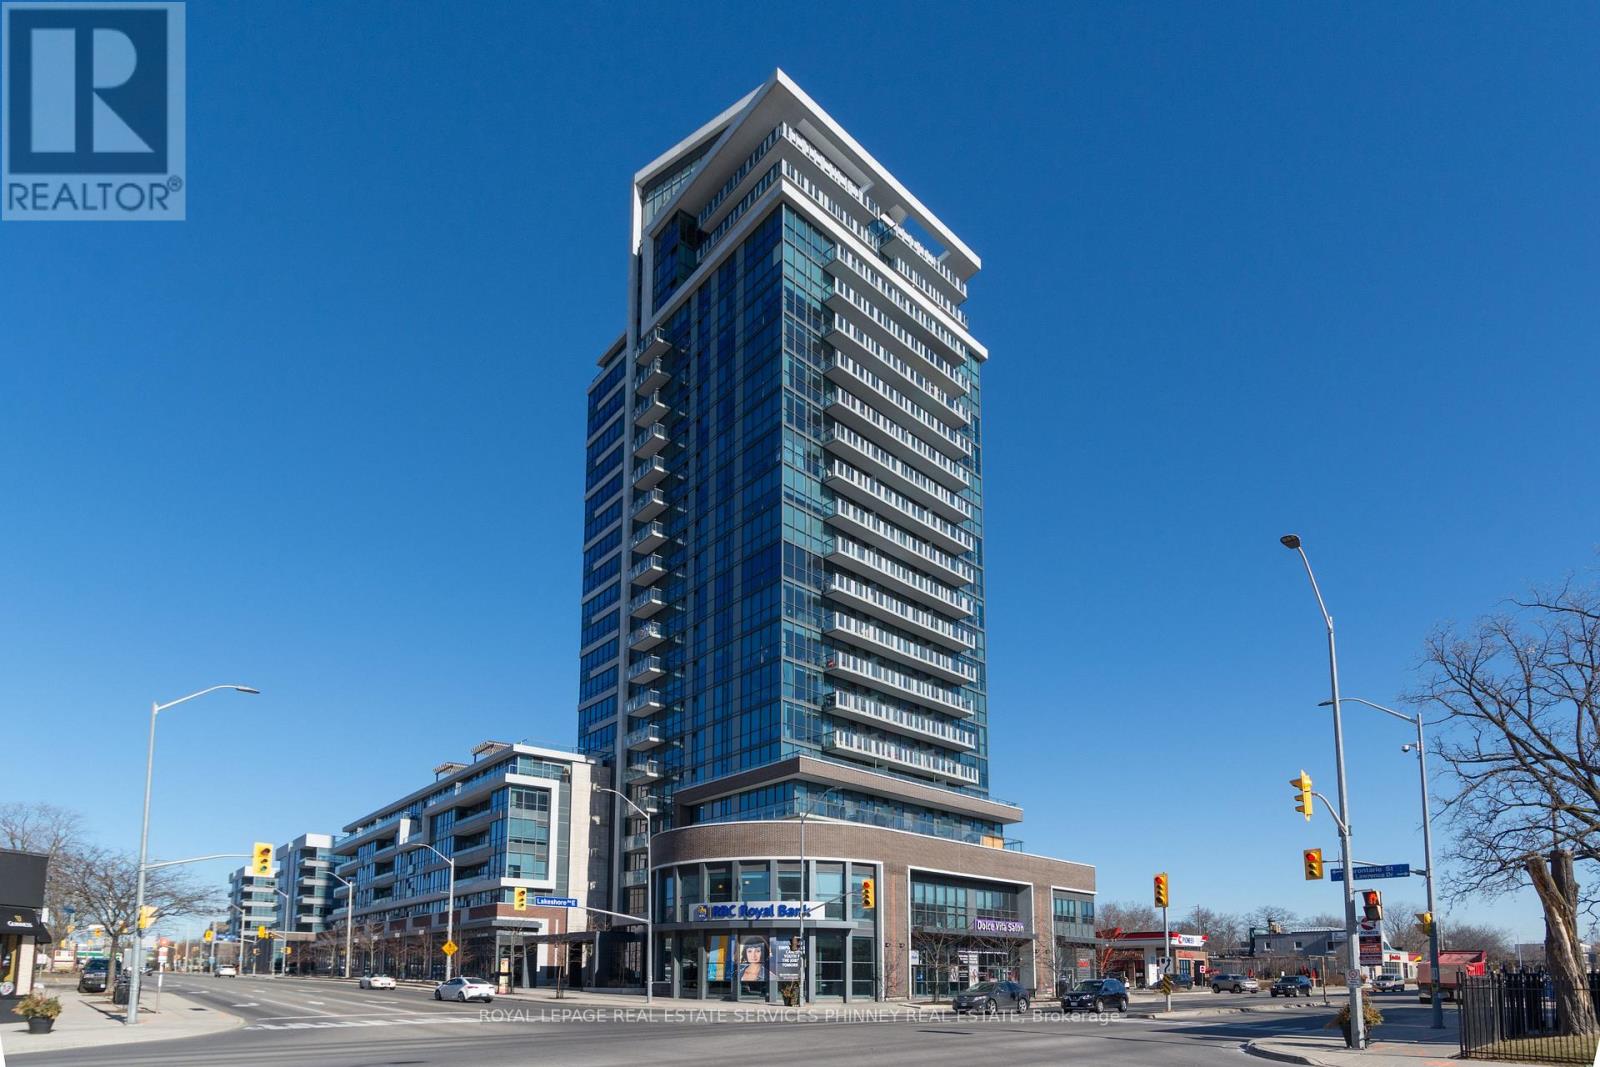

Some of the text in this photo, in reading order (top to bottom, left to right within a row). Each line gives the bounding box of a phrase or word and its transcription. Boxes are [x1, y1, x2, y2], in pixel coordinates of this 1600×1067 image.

[536, 898, 567, 906] Lakeshore
[712, 904, 811, 920] RBC Royal Bank
[977, 920, 1024, 932] Dolce Vita Salon
